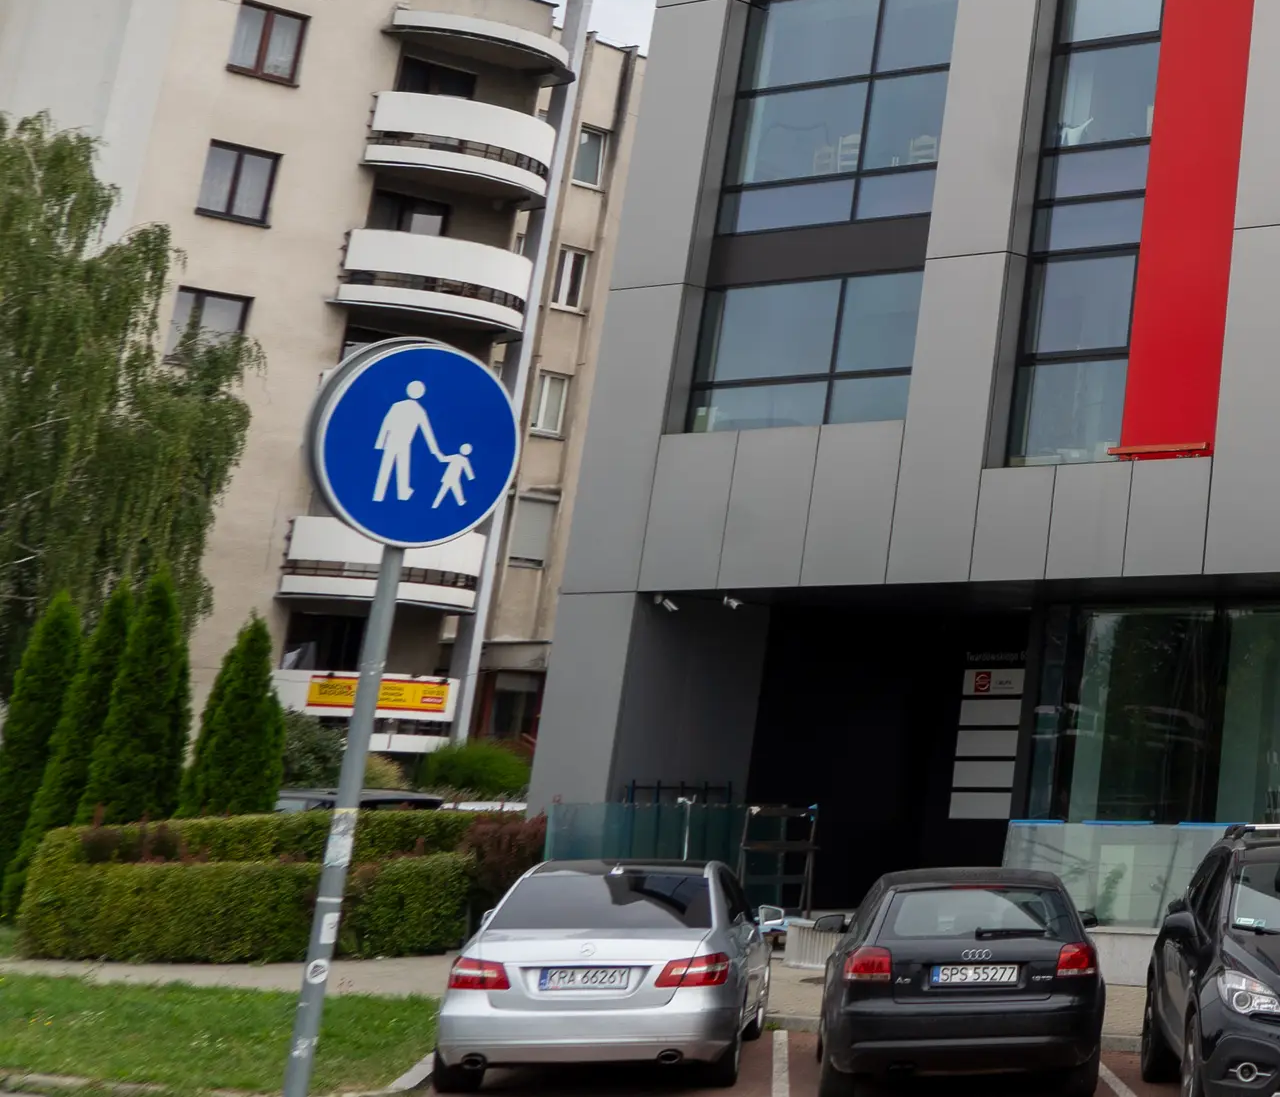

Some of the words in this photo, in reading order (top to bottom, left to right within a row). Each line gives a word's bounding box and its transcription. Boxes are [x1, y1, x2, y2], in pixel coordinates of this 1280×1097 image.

[548, 969, 576, 985] KRA
[581, 969, 627, 985] 6626Y
[940, 967, 968, 982] SPS
[973, 966, 1016, 981] 55277
